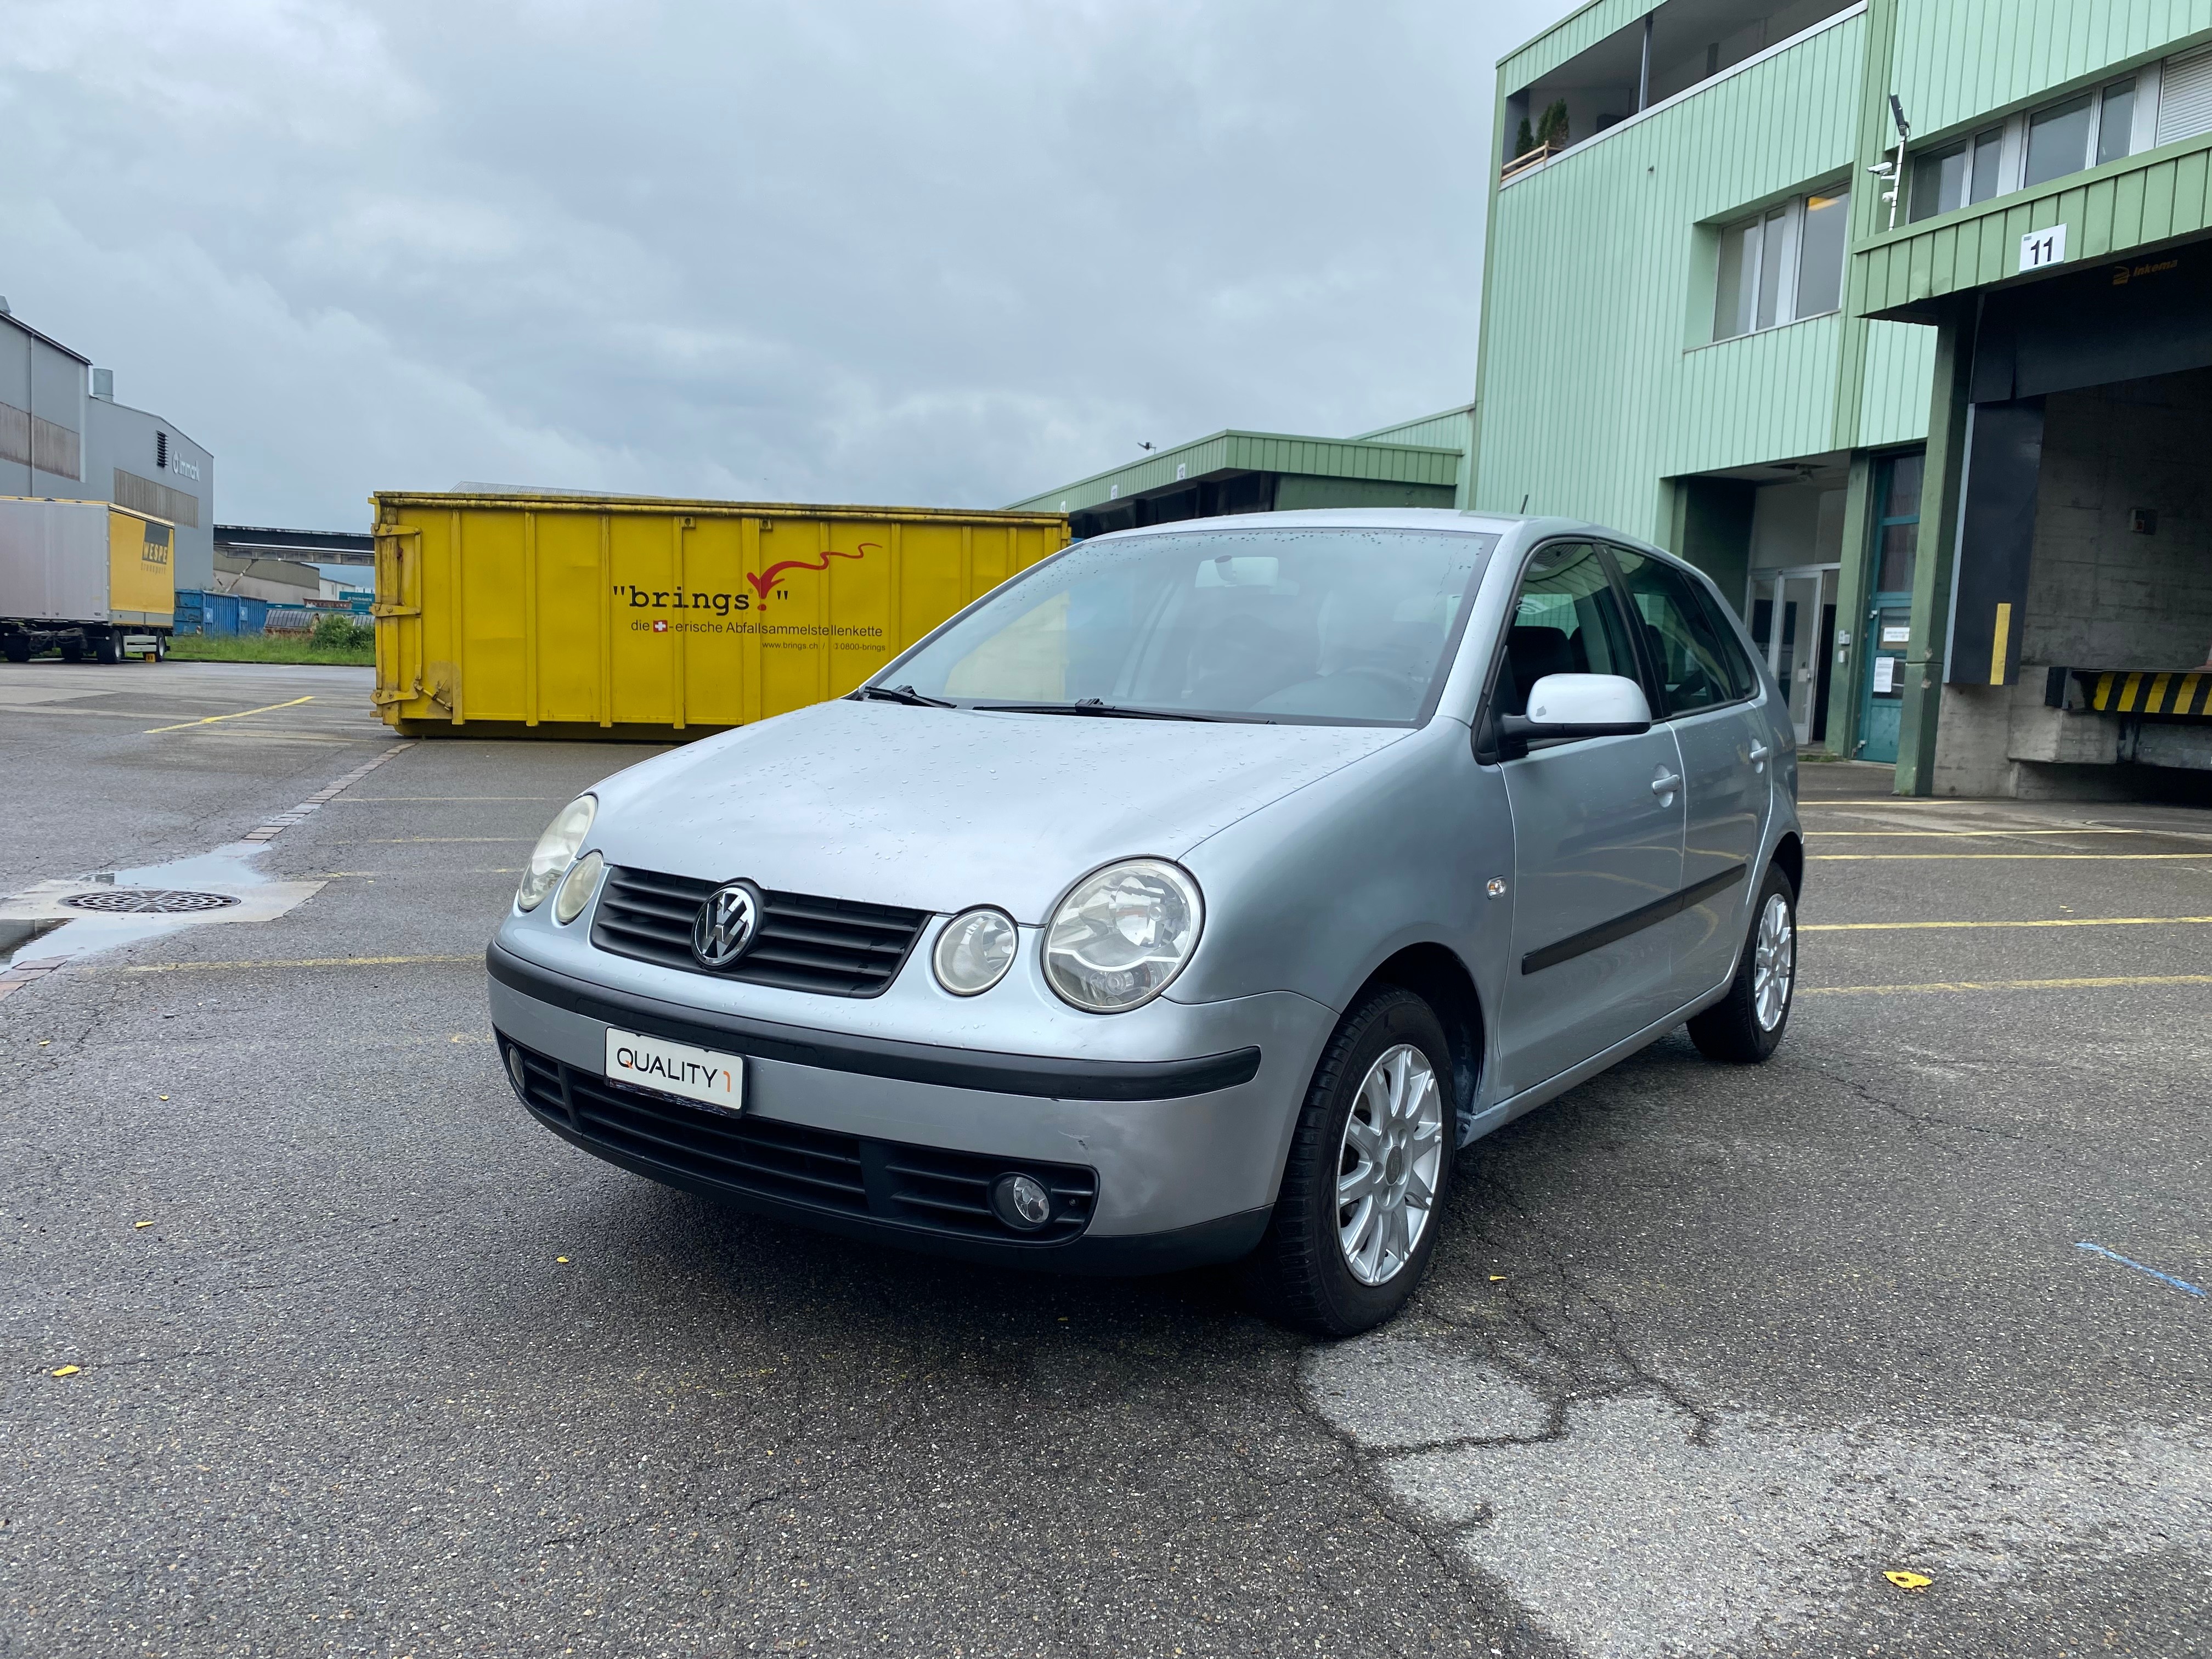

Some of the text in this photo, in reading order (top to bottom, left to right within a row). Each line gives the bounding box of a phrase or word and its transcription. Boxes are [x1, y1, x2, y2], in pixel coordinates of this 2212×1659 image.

[2030, 236, 2053, 265] 11
[143, 541, 167, 562] WESPE
[631, 620, 650, 630] die
[726, 622, 882, 637] Abfallsammelstellenkette
[762, 641, 818, 651] www.brings.ch
[840, 643, 885, 652] 0800-brings
[617, 1047, 731, 1092] QUALITY 1
